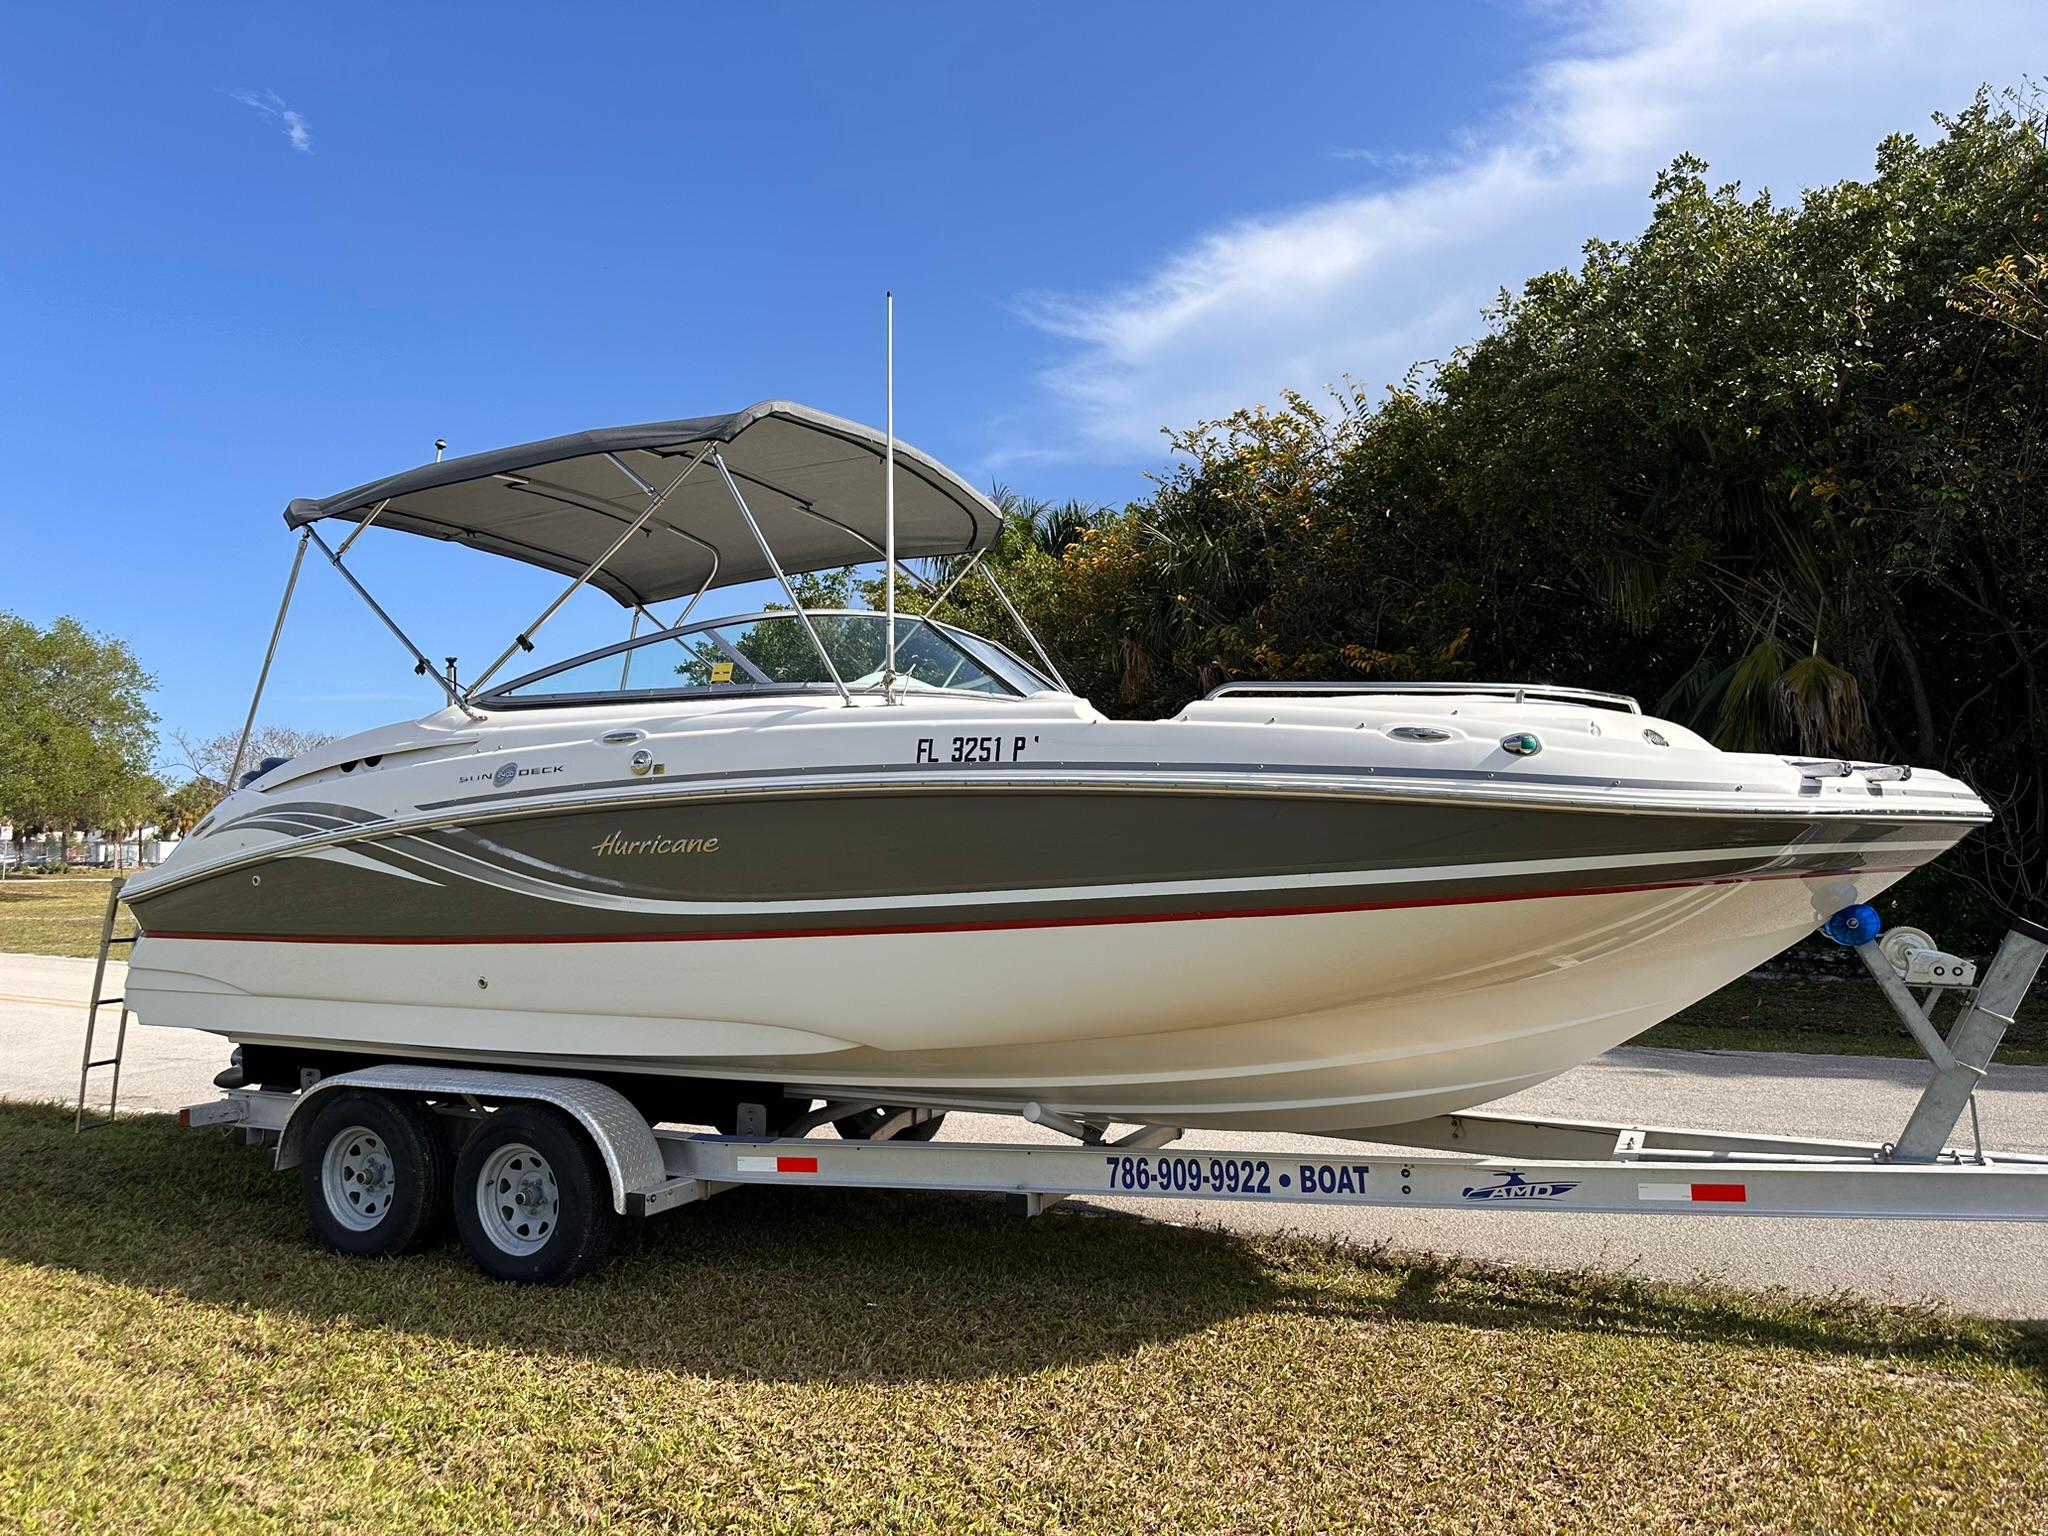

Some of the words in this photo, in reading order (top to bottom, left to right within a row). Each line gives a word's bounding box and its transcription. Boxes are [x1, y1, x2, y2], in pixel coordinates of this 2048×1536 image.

[917, 738, 939, 763] FL
[951, 736, 1001, 762] 3251
[1013, 736, 1026, 762] P
[518, 764, 564, 777] DECK
[592, 830, 720, 857] Hurricane
[1106, 1156, 1271, 1194] 786-909-9922
[1299, 1164, 1370, 1194] BOAT
[1489, 1183, 1553, 1198] AMD
